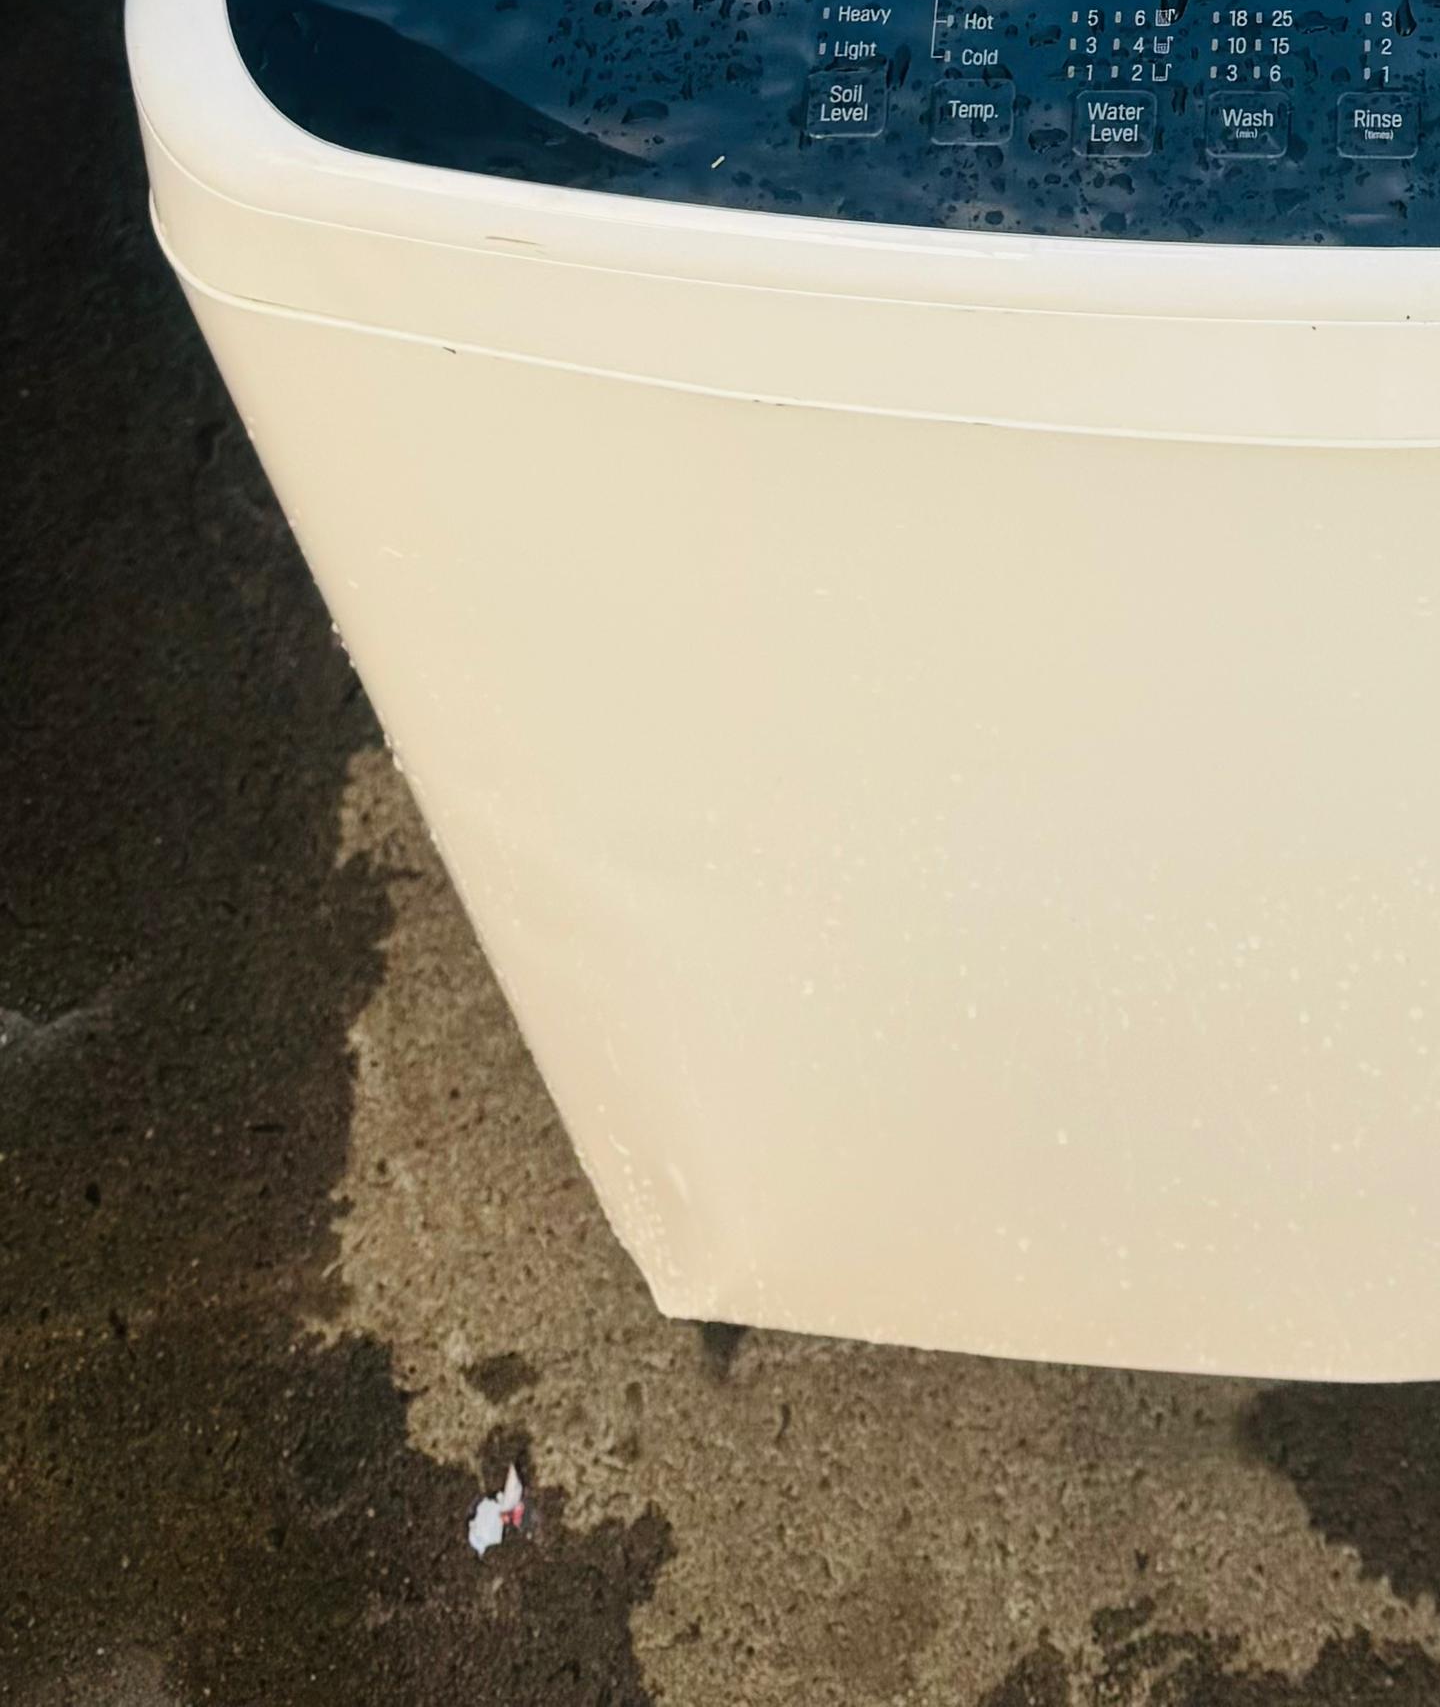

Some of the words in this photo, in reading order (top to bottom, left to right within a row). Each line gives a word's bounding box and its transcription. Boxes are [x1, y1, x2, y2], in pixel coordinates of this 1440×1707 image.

[838, 6, 891, 26] Heavy
[964, 12, 994, 30] Hot
[1087, 10, 1099, 27] 5
[1134, 10, 1146, 27] 6
[1229, 10, 1249, 27] 18
[1271, 11, 1293, 28] 25
[1381, 11, 1393, 28] 3
[833, 40, 877, 61] Light
[1085, 37, 1097, 54] 3
[1132, 37, 1145, 54] 4
[1227, 38, 1247, 54] 10
[1270, 38, 1290, 54] 15
[1380, 39, 1392, 55] 2
[962, 47, 998, 66] Cold
[1085, 65, 1094, 82] 1
[1131, 65, 1143, 82] 2
[1226, 65, 1238, 82] 3
[1269, 65, 1281, 82] 6
[1382, 66, 1390, 83] 1
[829, 84, 863, 104] Soil
[820, 103, 869, 122] Level
[948, 100, 999, 122] Temp.
[1087, 102, 1145, 122] Water
[1222, 108, 1274, 127] Wash
[1354, 109, 1402, 128] Rinse
[1090, 124, 1139, 143] Level
